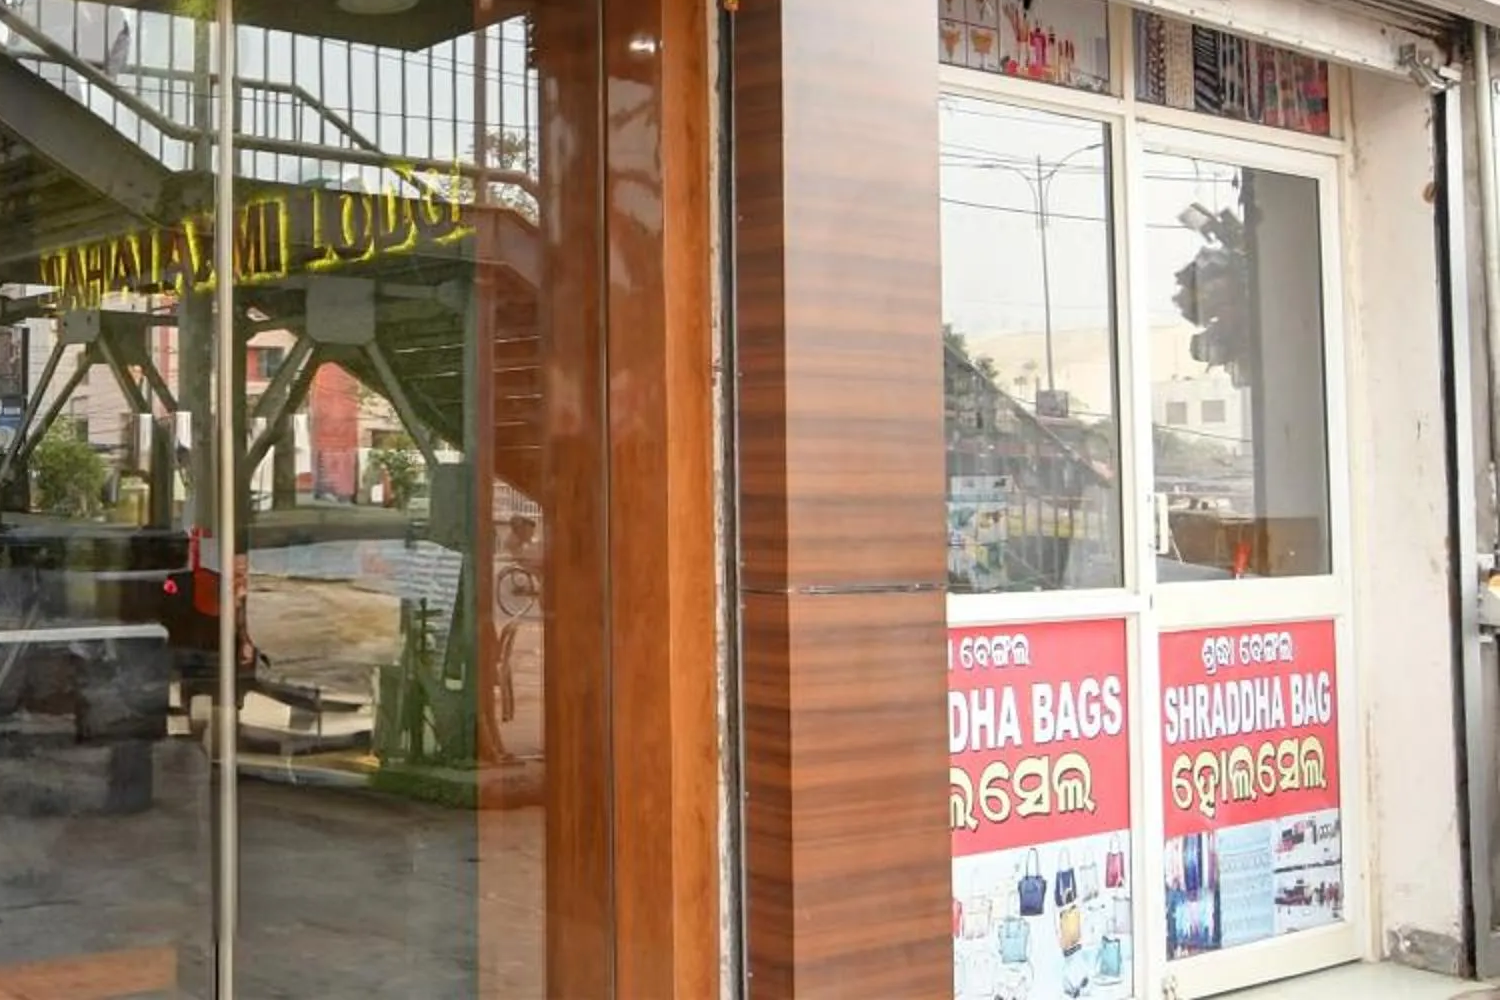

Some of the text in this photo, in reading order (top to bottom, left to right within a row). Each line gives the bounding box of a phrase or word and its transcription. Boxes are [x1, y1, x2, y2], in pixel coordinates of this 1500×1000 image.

[1031, 675, 1123, 744] BAGS
[1164, 670, 1332, 745] SHRADDHA BAG
